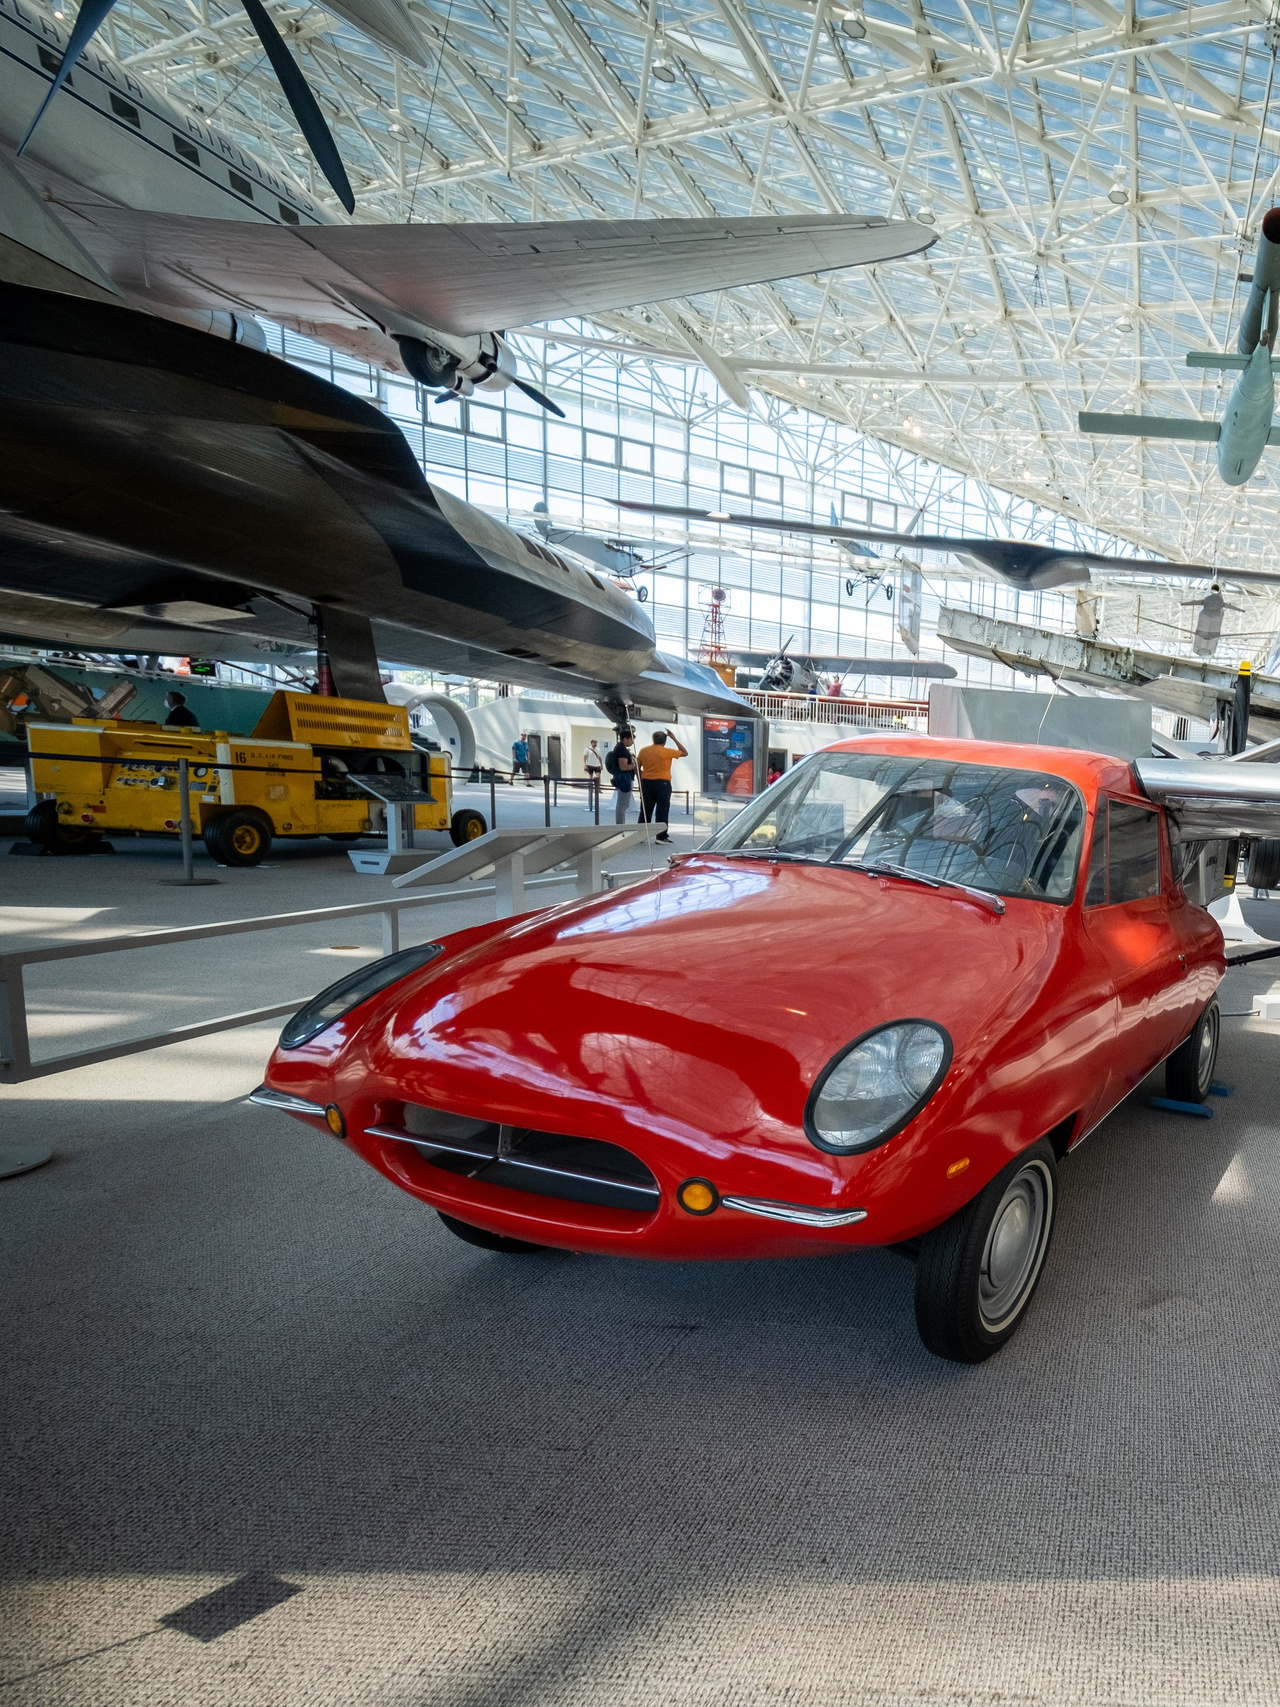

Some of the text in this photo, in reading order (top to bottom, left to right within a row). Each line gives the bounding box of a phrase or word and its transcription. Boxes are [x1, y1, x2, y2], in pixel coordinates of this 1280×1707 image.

[0, 0, 314, 212] LAKA AIRLINES
[235, 751, 247, 763] 16
